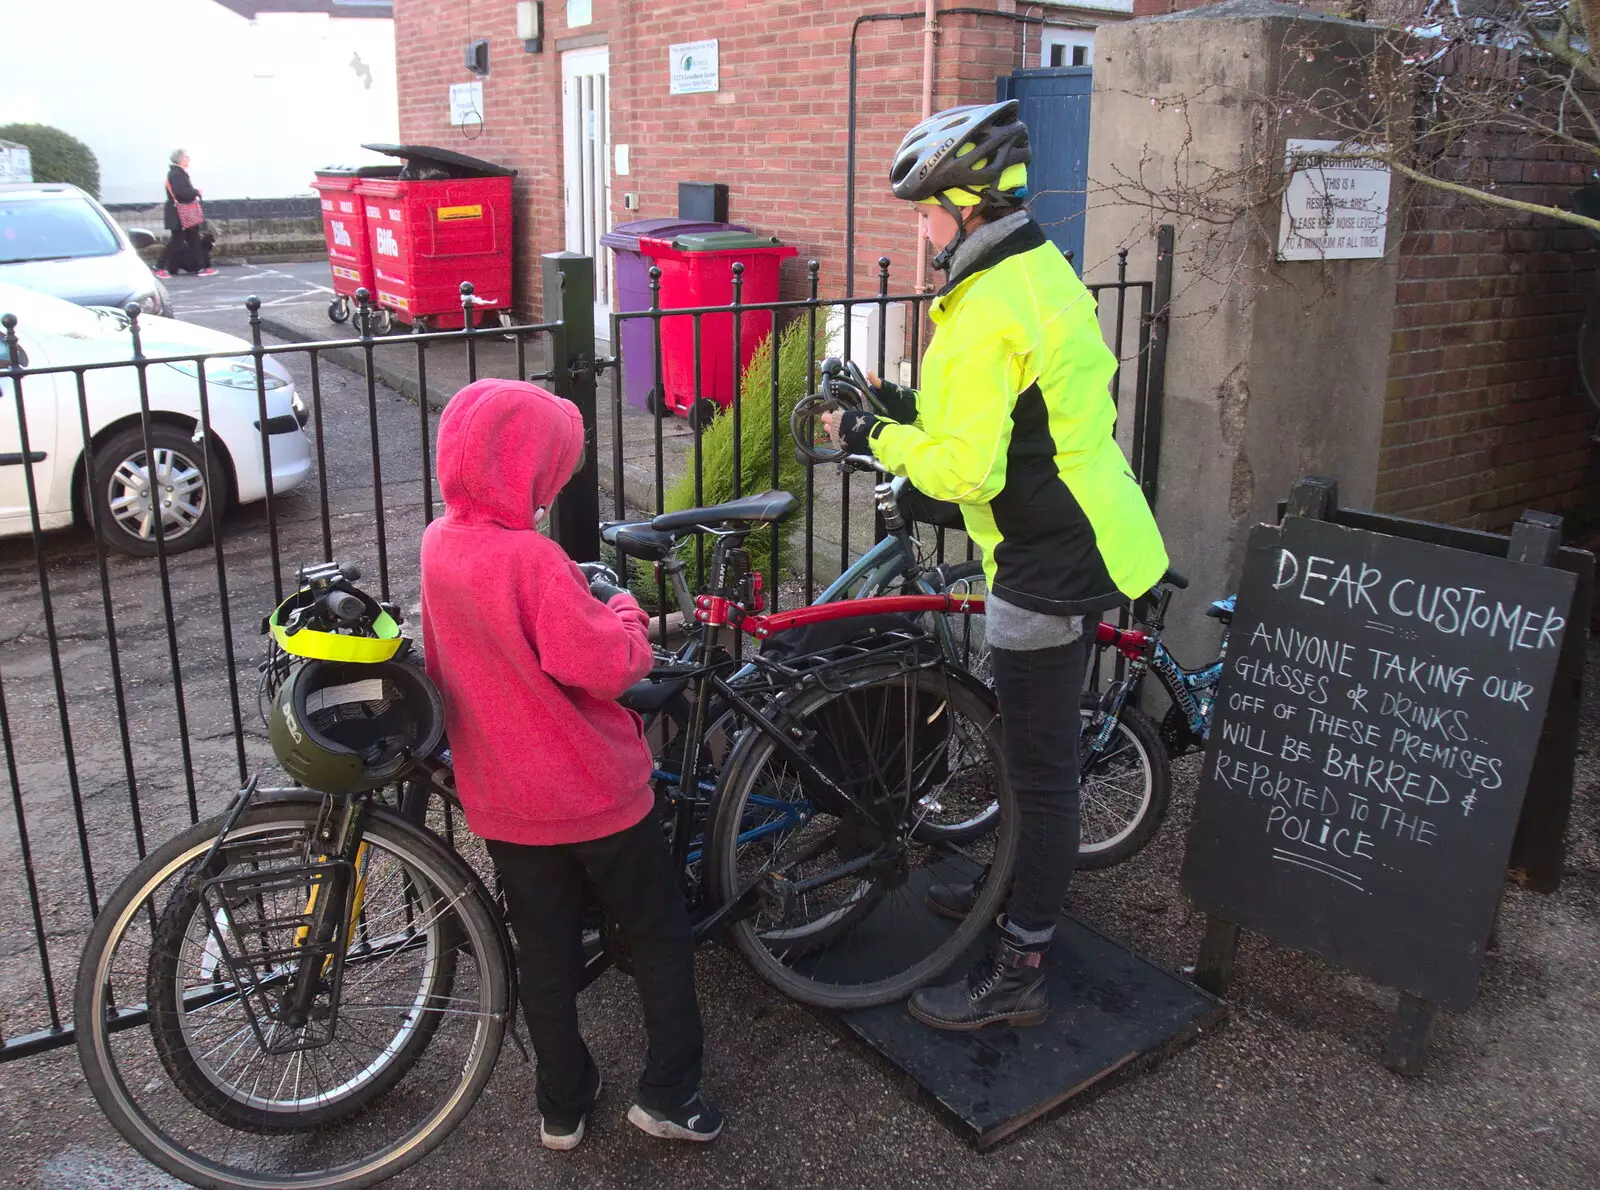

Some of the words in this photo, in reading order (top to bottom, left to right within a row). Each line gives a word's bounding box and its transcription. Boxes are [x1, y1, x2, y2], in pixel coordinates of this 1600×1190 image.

[927, 137, 955, 167] GIRO
[1325, 178, 1340, 190] THIS
[1342, 178, 1349, 190] IS
[1350, 178, 1356, 190] A
[1297, 237, 1303, 249] A
[1337, 236, 1346, 248] AT
[1346, 236, 1358, 248] ALL
[1360, 236, 1379, 248] TIMES
[1336, 217, 1355, 229] NOISE
[1357, 216, 1379, 229] LEVELS
[1272, 548, 1382, 615] DEAR
[1388, 578, 1566, 652] CUSTOMER
[1235, 655, 1330, 704] GLASSES
[1249, 622, 1356, 678] ANYONE
[1482, 675, 1534, 712] OUR
[1229, 692, 1266, 714] OFF
[1273, 703, 1298, 720] OF
[1307, 707, 1382, 747] THESE
[1280, 734, 1312, 762] BE
[1322, 743, 1450, 806] BARRED
[1378, 802, 1438, 846] THE
